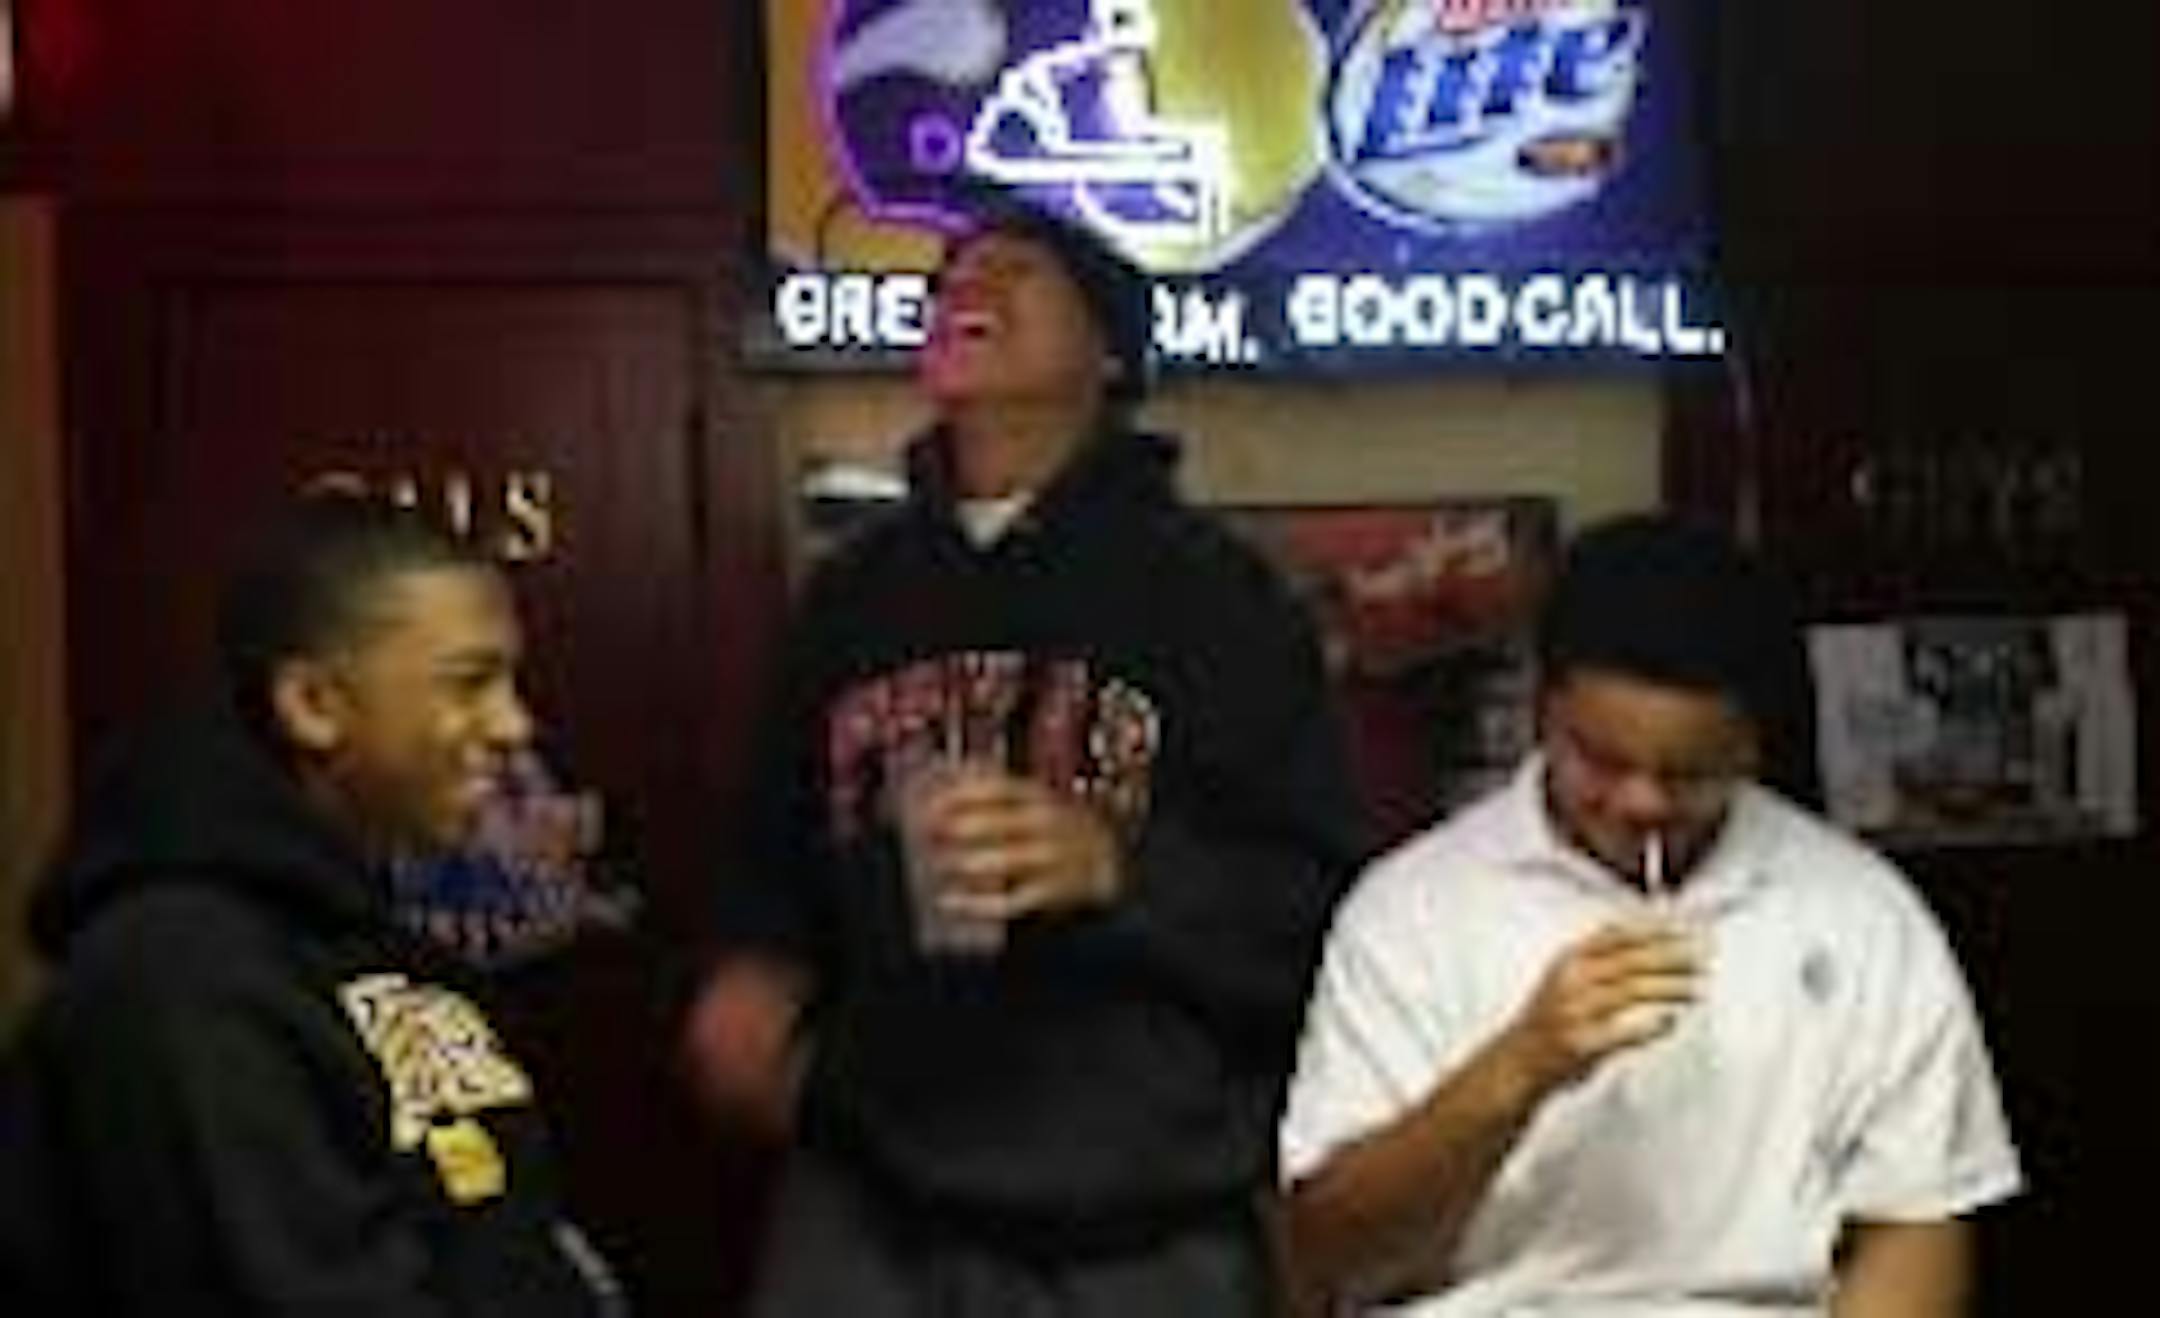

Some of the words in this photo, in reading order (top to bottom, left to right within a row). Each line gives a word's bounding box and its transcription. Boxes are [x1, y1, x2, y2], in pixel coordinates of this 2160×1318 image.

[775, 272, 932, 347] GRE
[1287, 272, 1508, 348] GOOD
[1514, 272, 1726, 356] CALL.
